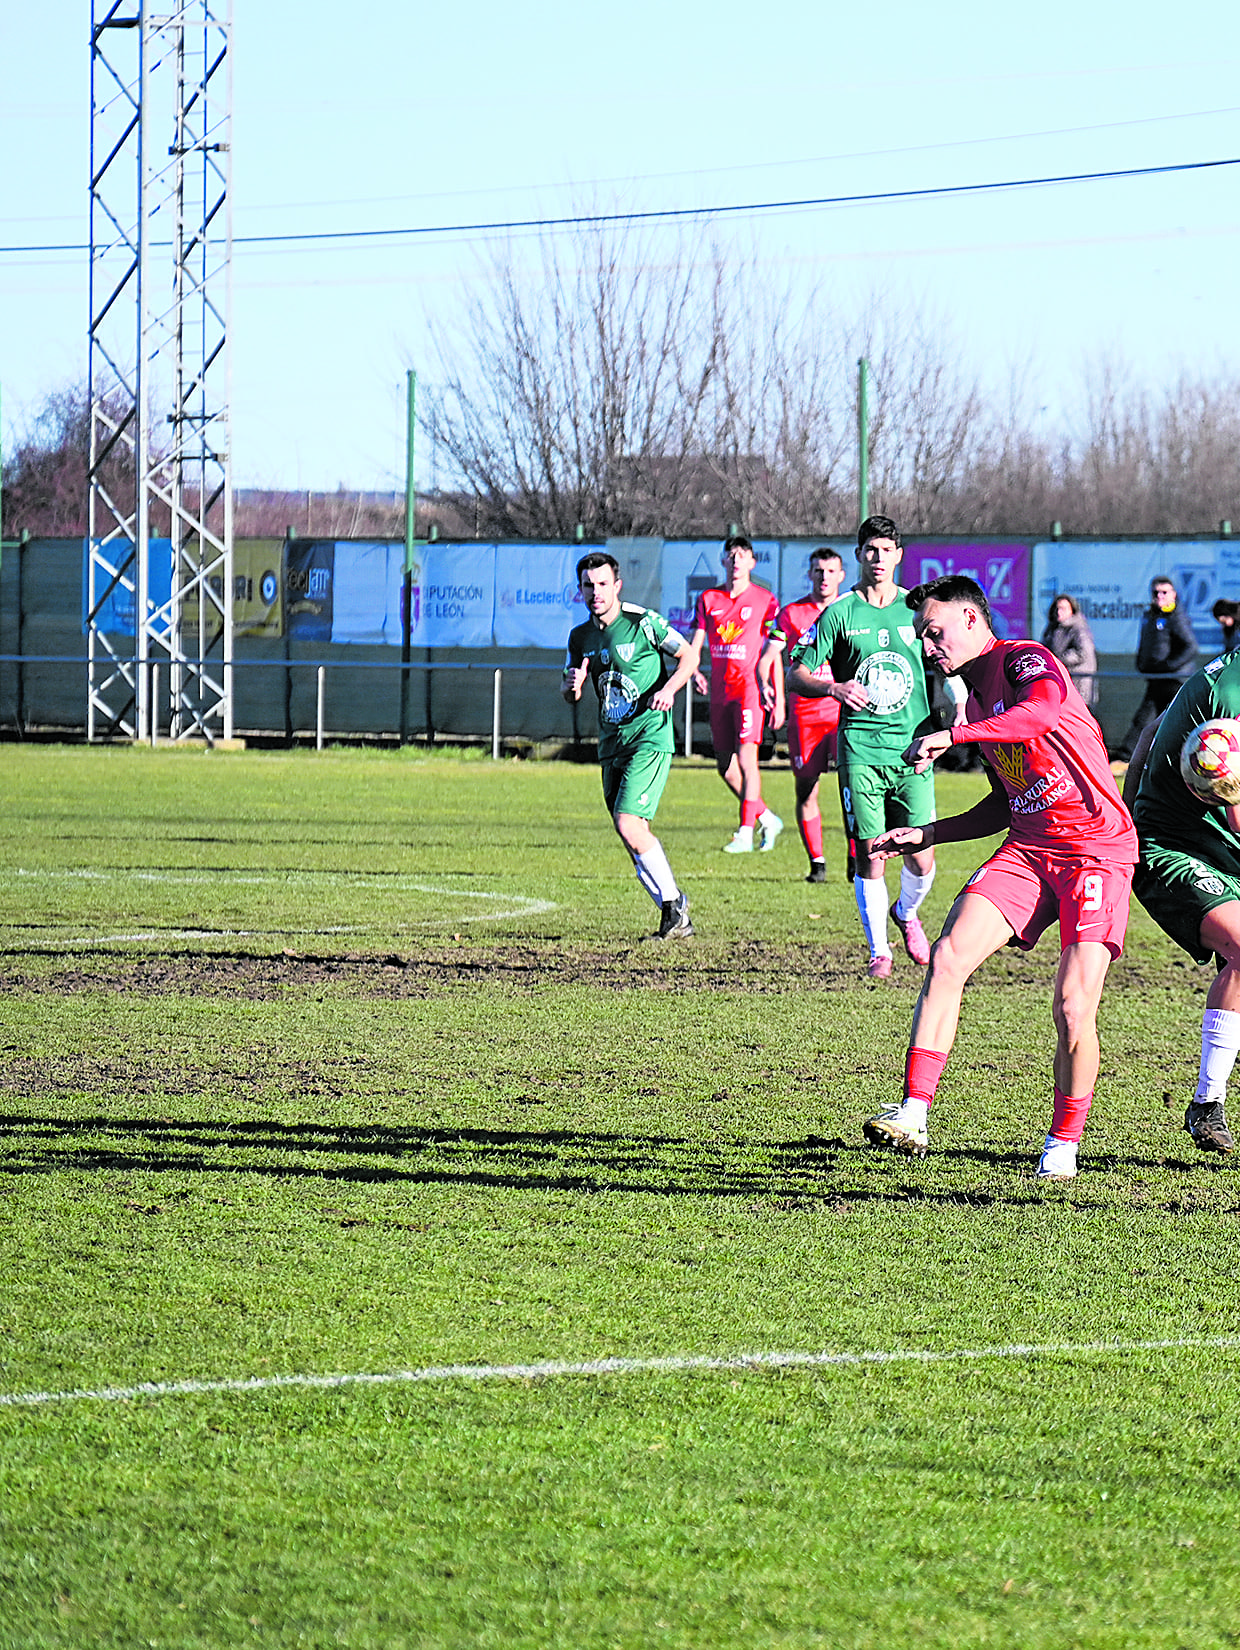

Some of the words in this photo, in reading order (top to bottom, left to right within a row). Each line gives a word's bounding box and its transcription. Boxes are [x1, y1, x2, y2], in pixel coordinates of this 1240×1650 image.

[423, 584, 483, 600] IPUTACIÓN
[742, 708, 753, 729] 3
[1023, 766, 1066, 801] RURAL
[843, 786, 852, 813] 8
[1082, 875, 1104, 911] 9
